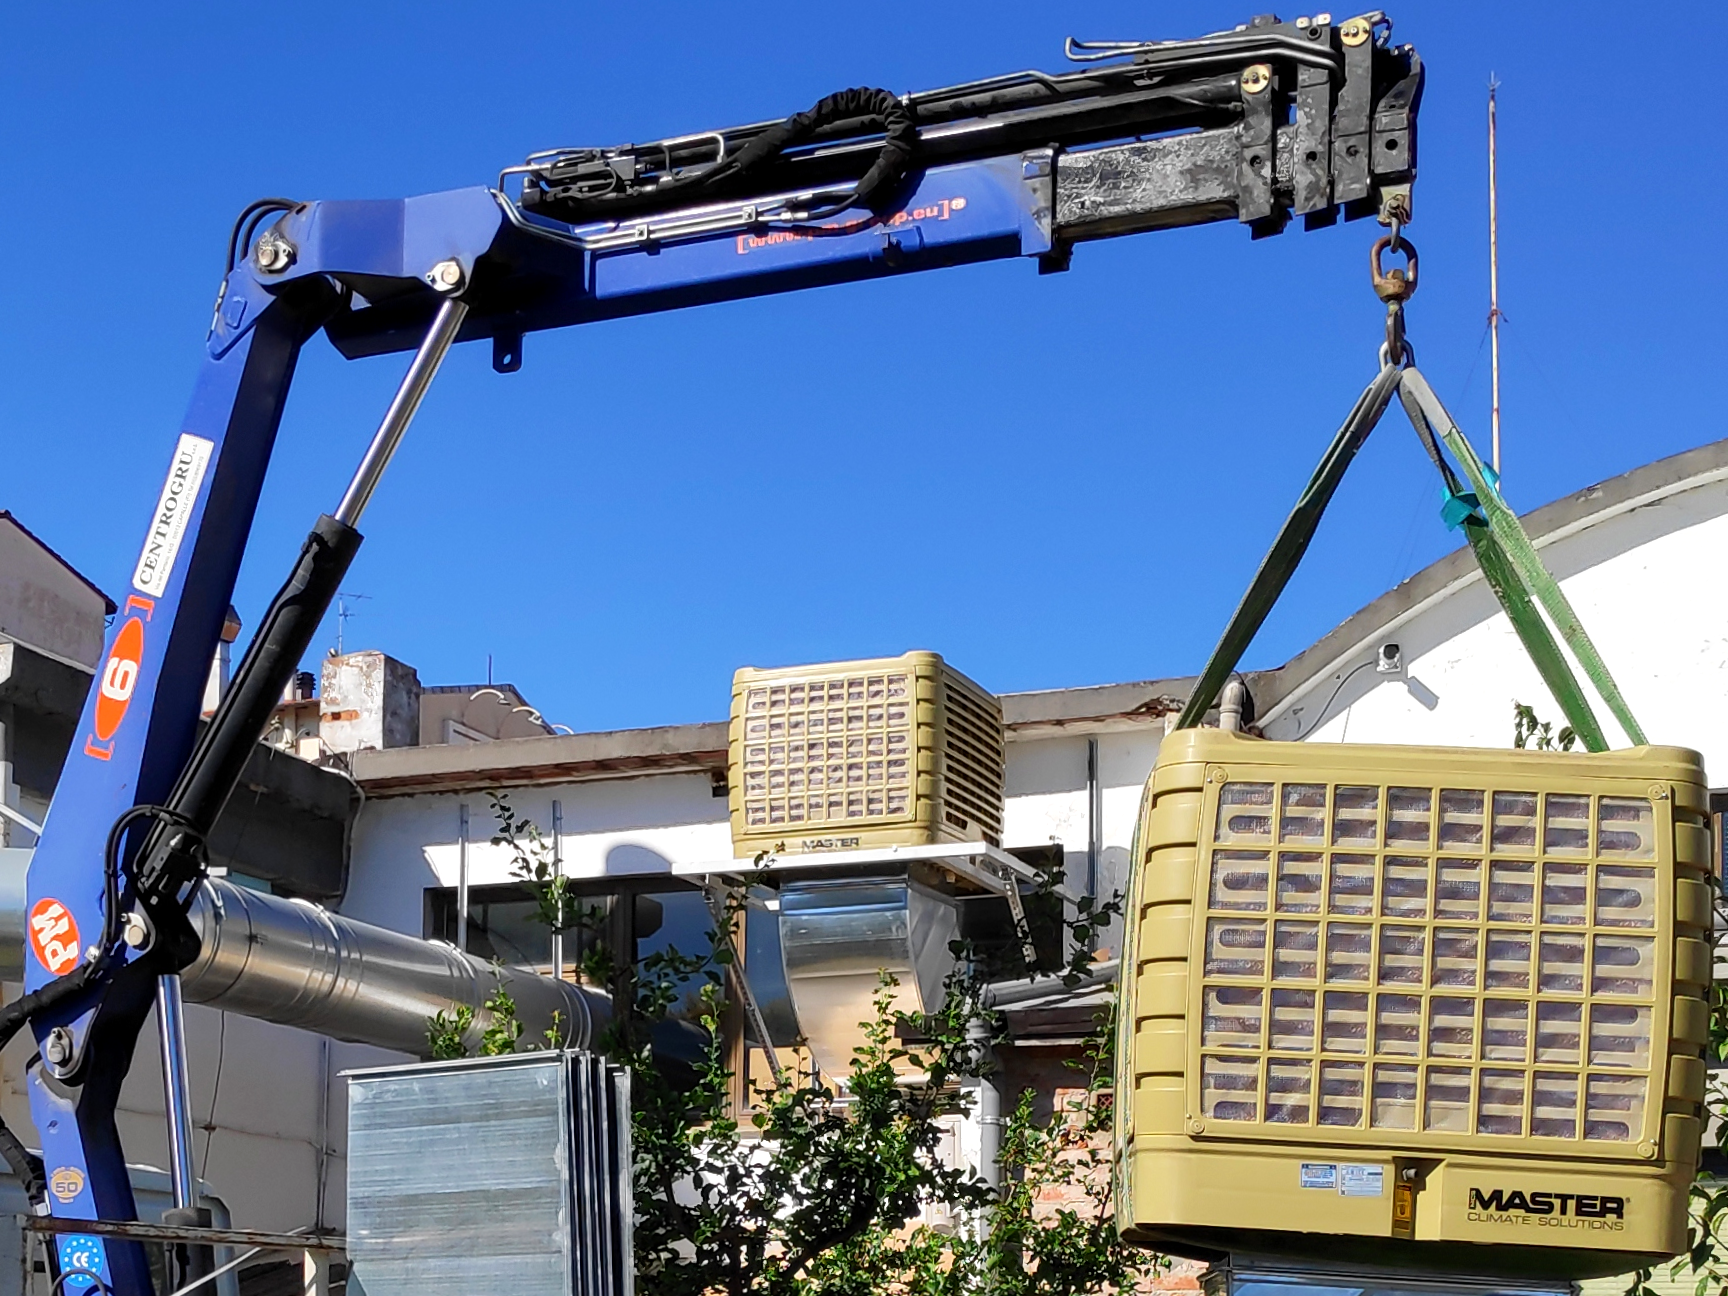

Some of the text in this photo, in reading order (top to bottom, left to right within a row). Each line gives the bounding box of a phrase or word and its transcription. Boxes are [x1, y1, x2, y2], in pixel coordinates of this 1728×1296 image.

[139, 450, 194, 586] CENTROGRU
[101, 656, 138, 702] 6
[802, 837, 860, 850] MASTER
[32, 902, 80, 973] PM
[55, 1182, 79, 1194] 50
[1468, 1187, 1625, 1221] MASTER
[1467, 1212, 1625, 1232] CLIMATE SOLUTIONS
